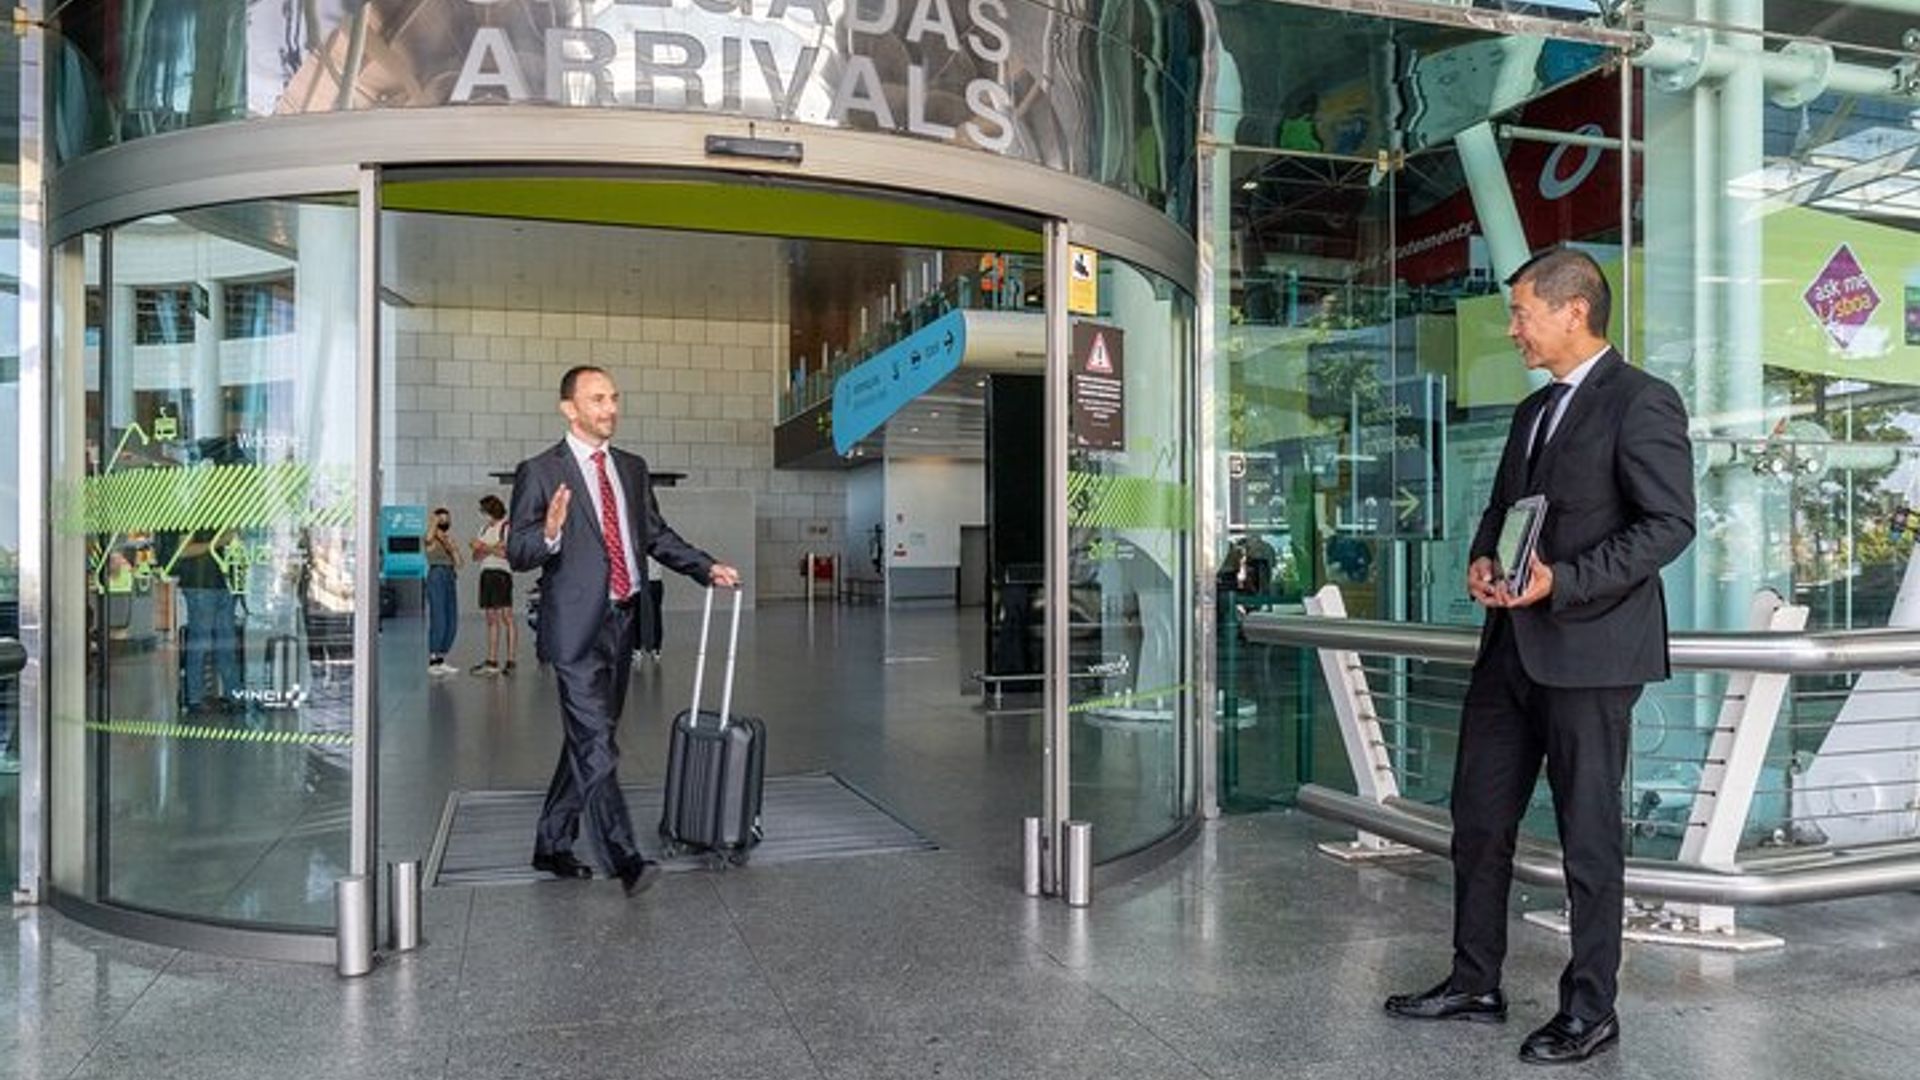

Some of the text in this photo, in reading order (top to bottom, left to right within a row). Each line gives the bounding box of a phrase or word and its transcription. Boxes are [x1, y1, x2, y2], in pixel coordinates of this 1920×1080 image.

[450, 27, 1013, 156] ARRIVALS
[1815, 280, 1841, 300] ask
[231, 688, 282, 701] VINCI
